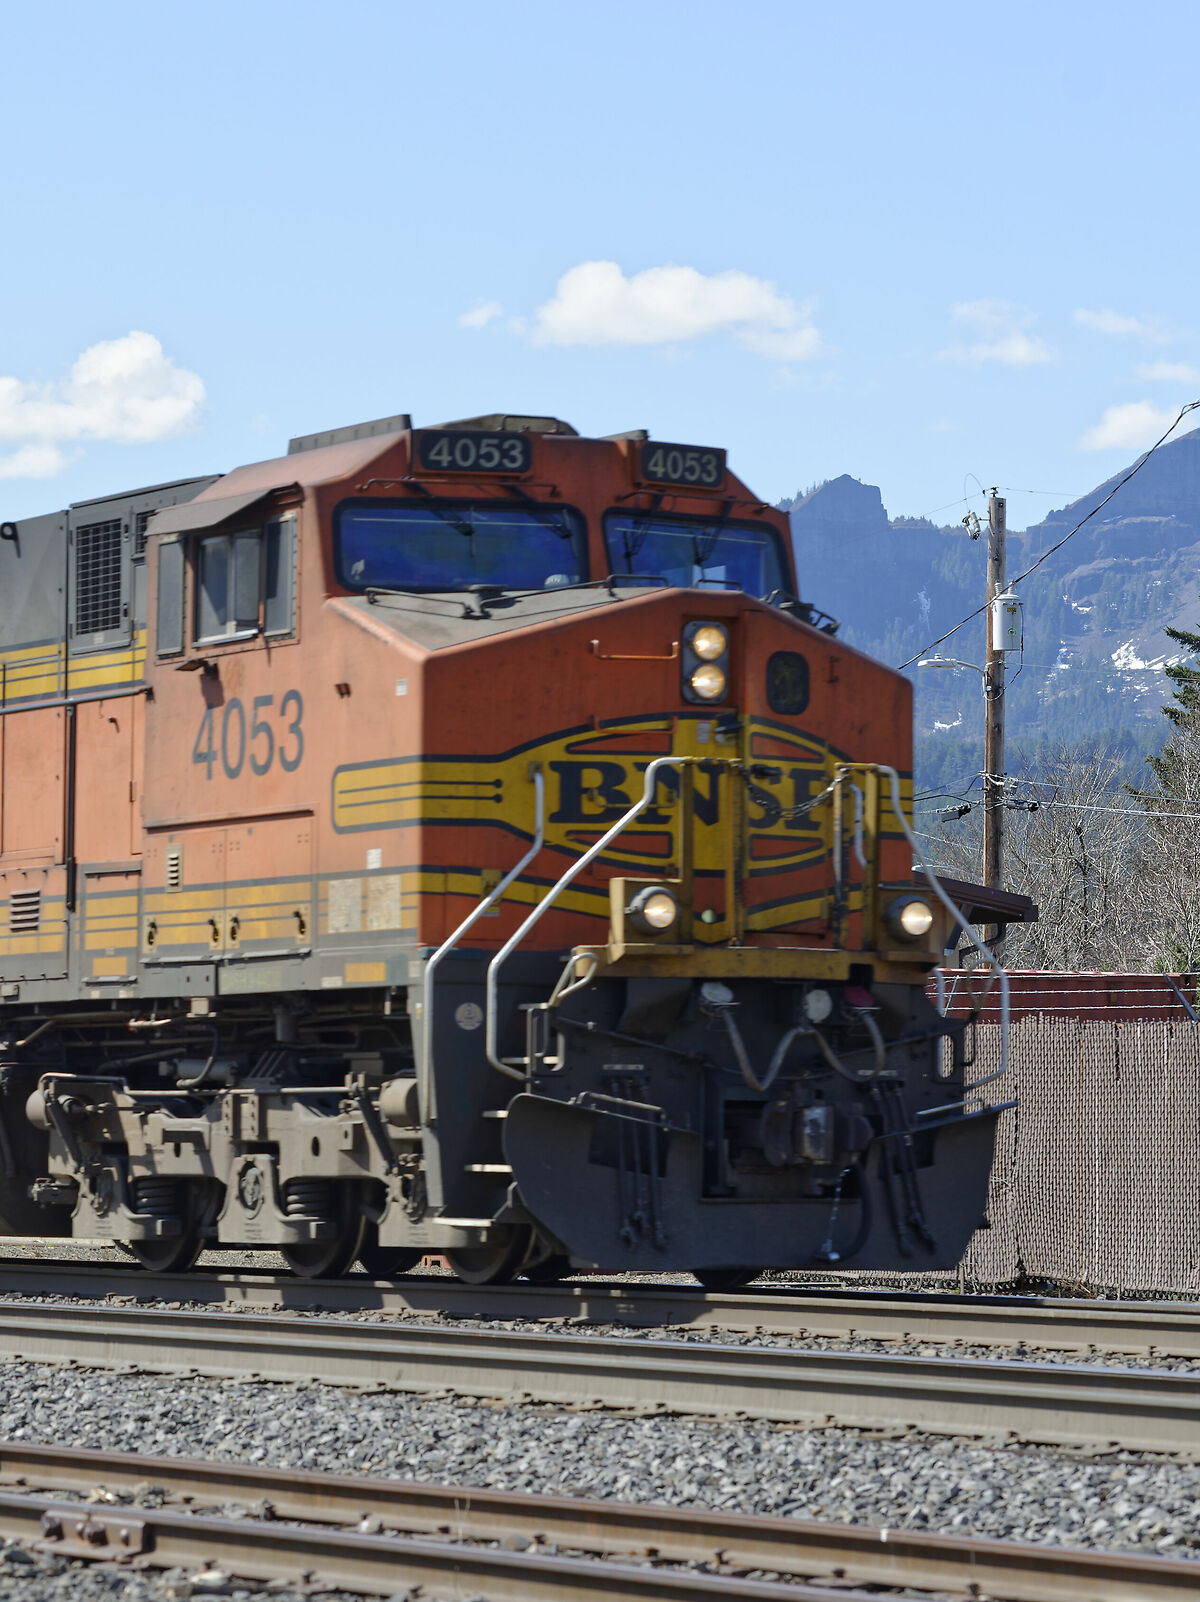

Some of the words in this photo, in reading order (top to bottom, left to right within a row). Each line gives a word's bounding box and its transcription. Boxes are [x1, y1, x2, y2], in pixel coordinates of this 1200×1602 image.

[427, 436, 525, 470] 4053
[647, 447, 719, 484] 4053
[192, 688, 305, 781] 4053
[548, 760, 832, 832] BNSF
